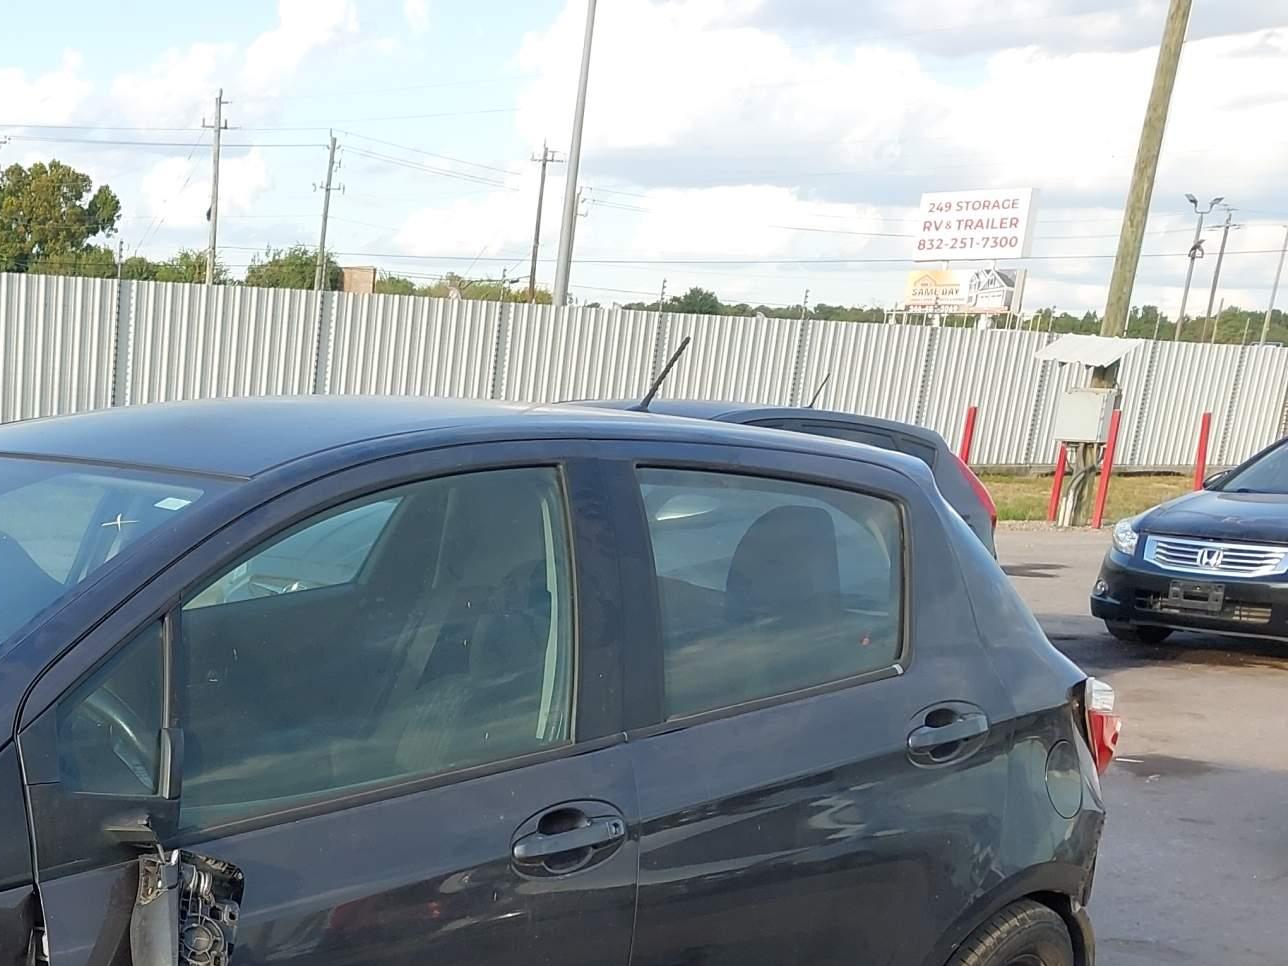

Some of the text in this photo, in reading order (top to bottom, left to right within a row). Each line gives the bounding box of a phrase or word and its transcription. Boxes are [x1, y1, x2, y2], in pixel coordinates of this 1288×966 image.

[928, 199, 1020, 213] 249 STORAGE
[956, 217, 1020, 231] TRAILER
[917, 236, 1018, 251] 832-251-7300
